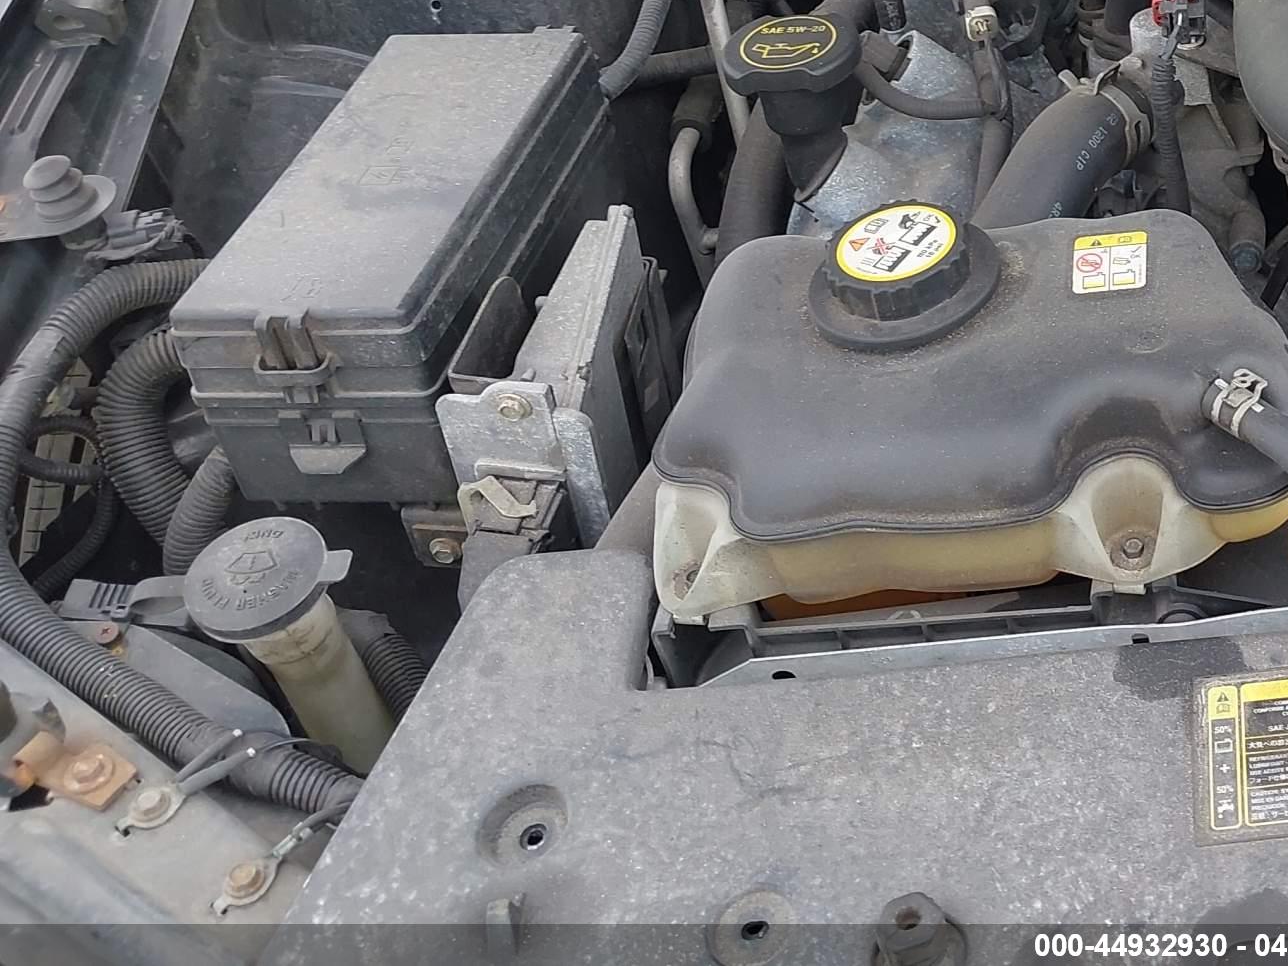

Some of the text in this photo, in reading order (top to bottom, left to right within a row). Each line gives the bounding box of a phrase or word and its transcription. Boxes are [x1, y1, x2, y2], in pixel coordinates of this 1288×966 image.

[786, 25, 826, 34] 5W-20
[1088, 126, 1108, 148] 1200
[1076, 150, 1090, 172] CIP
[202, 578, 230, 610] FLUID
[236, 570, 301, 611] WASHER
[1214, 725, 1232, 734] 50%
